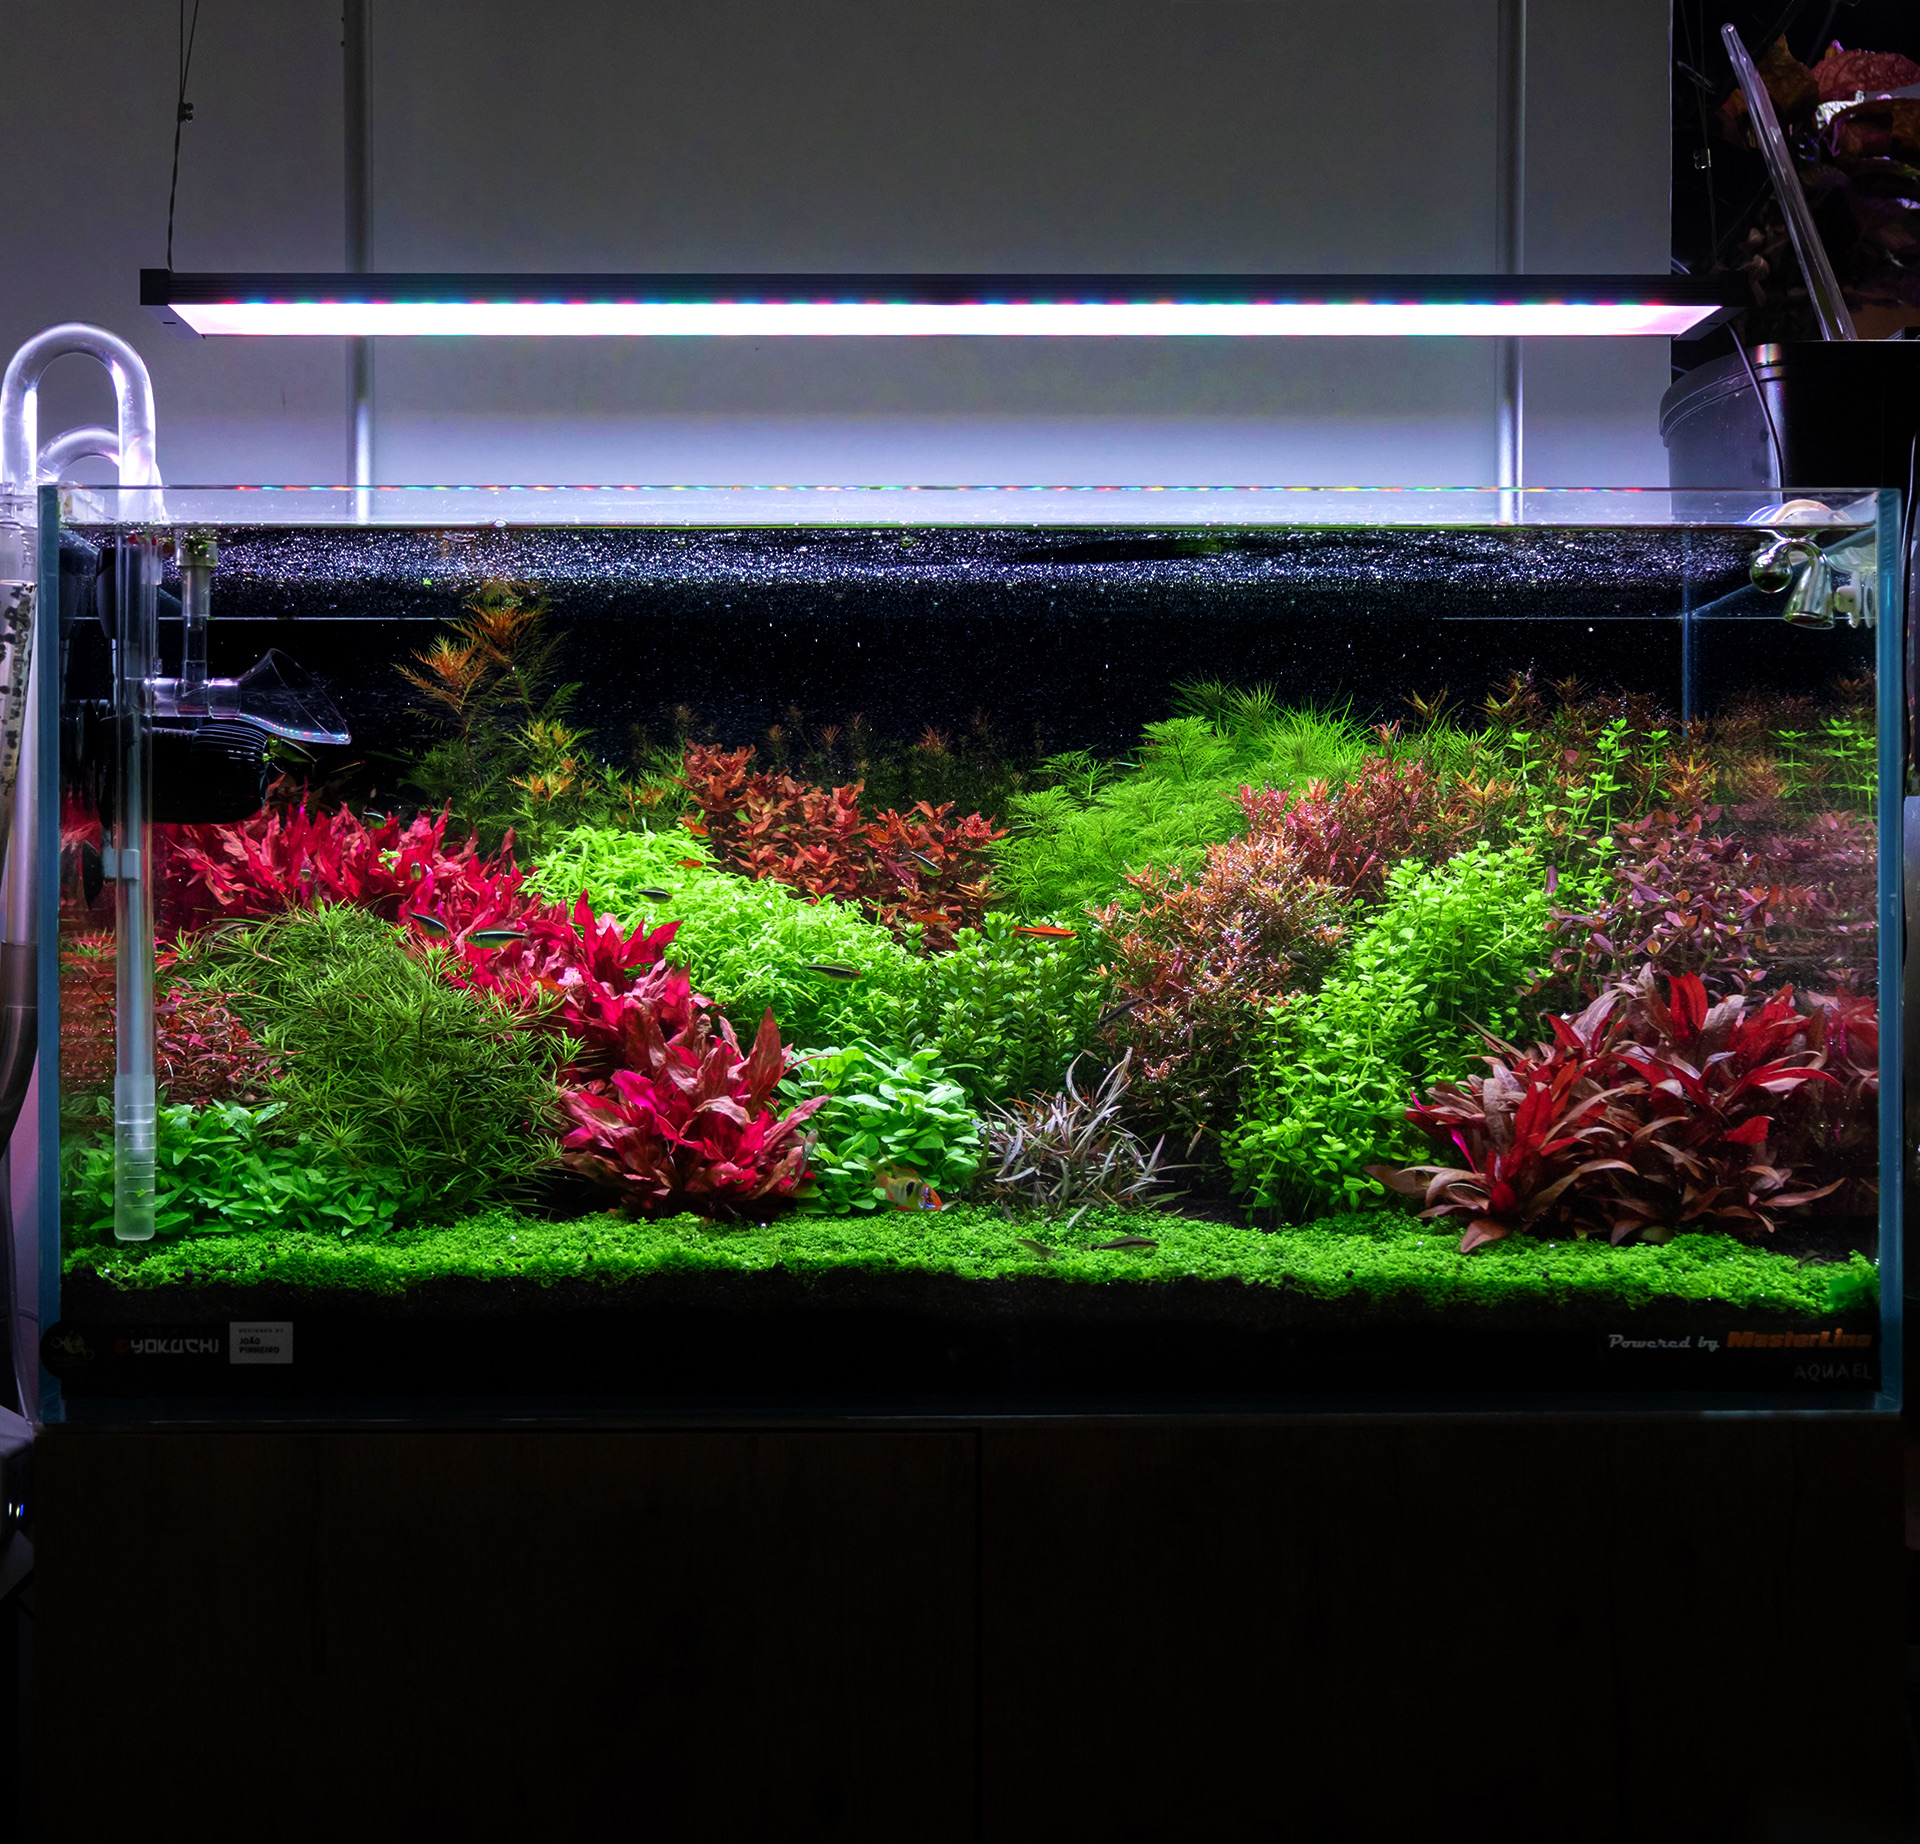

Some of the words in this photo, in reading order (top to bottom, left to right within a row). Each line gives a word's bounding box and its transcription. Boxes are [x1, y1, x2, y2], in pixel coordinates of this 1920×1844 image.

[239, 1345, 280, 1354] PINHEIRO
[1608, 1333, 1692, 1349] Powered
[1697, 1335, 1720, 1353] by
[1726, 1327, 1872, 1349] MasterLine
[1792, 1362, 1873, 1382] AQUAEL
